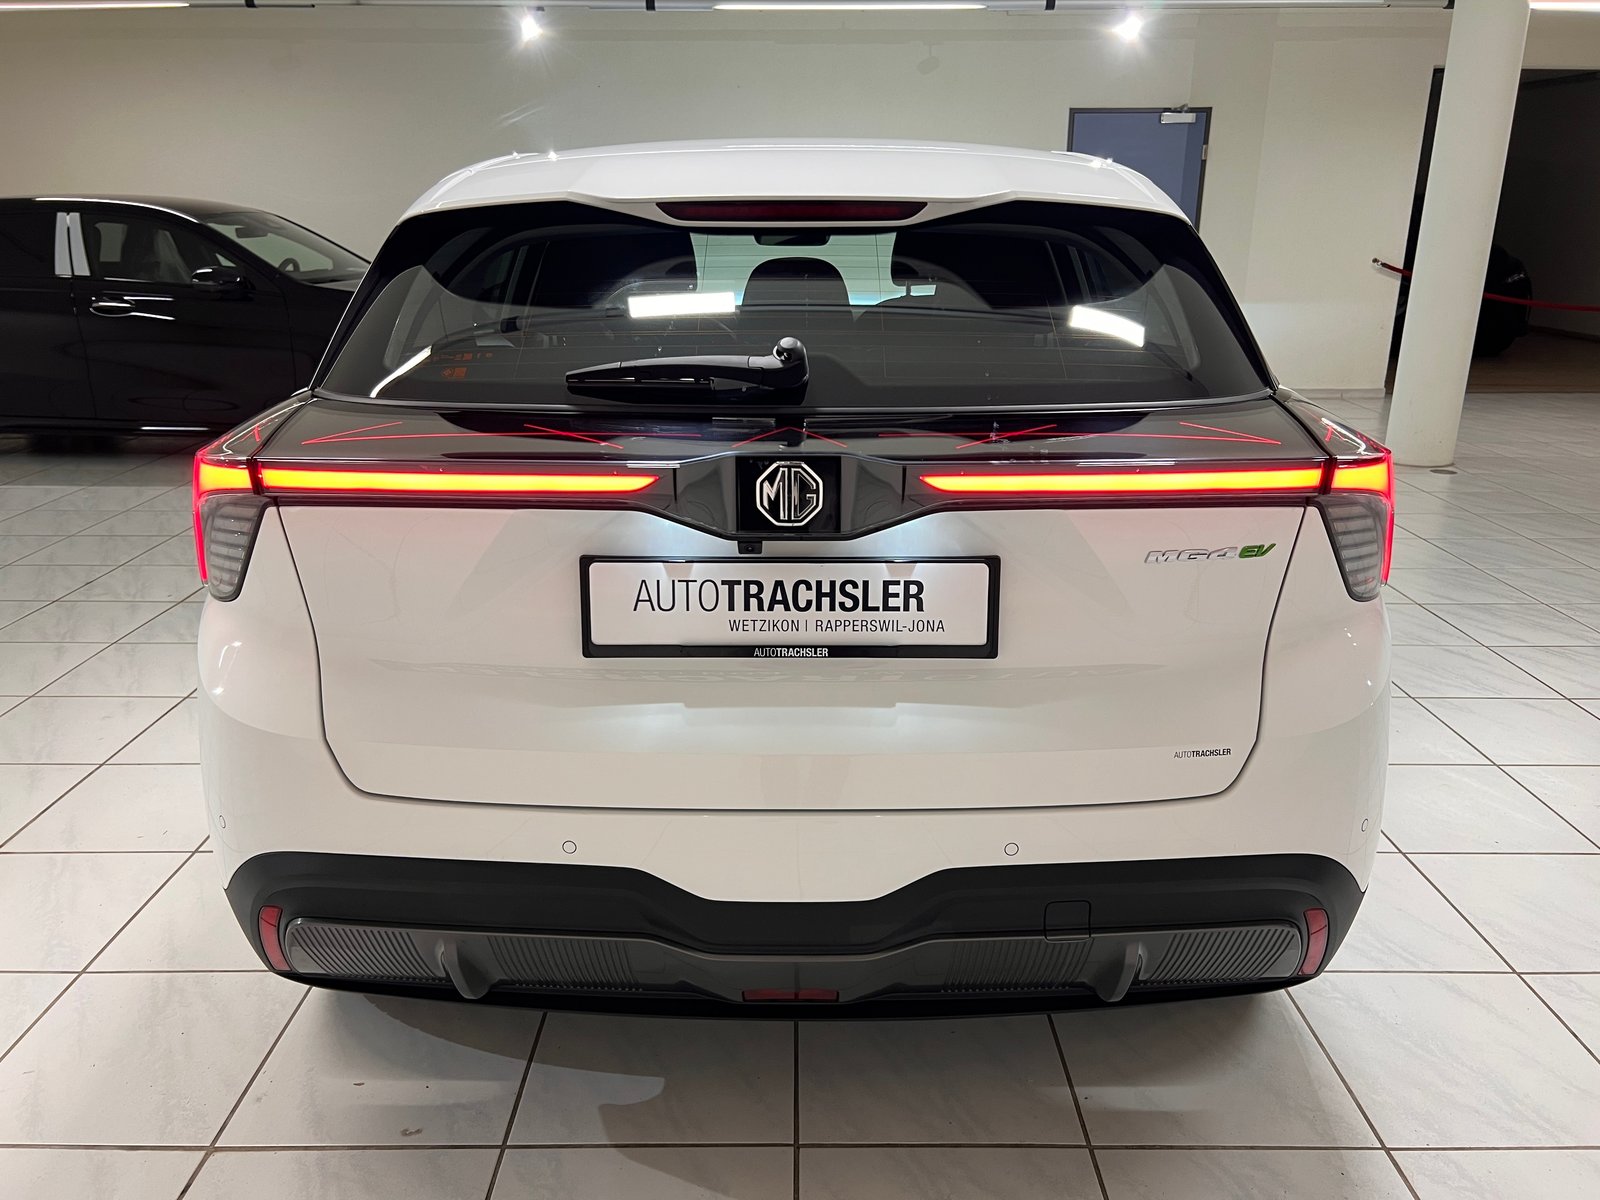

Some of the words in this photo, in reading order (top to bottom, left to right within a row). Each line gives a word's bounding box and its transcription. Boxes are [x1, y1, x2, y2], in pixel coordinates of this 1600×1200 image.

[762, 467, 817, 521] MG
[1238, 543, 1277, 559] EV
[633, 579, 925, 613] AUTOTRACHSLER
[728, 619, 800, 633] WETZIKON
[815, 619, 945, 633] RAPPERSWIL-JONA
[753, 647, 829, 658] AUTOTRACHSLER
[1173, 748, 1232, 759] AUTOTRACHSLER
